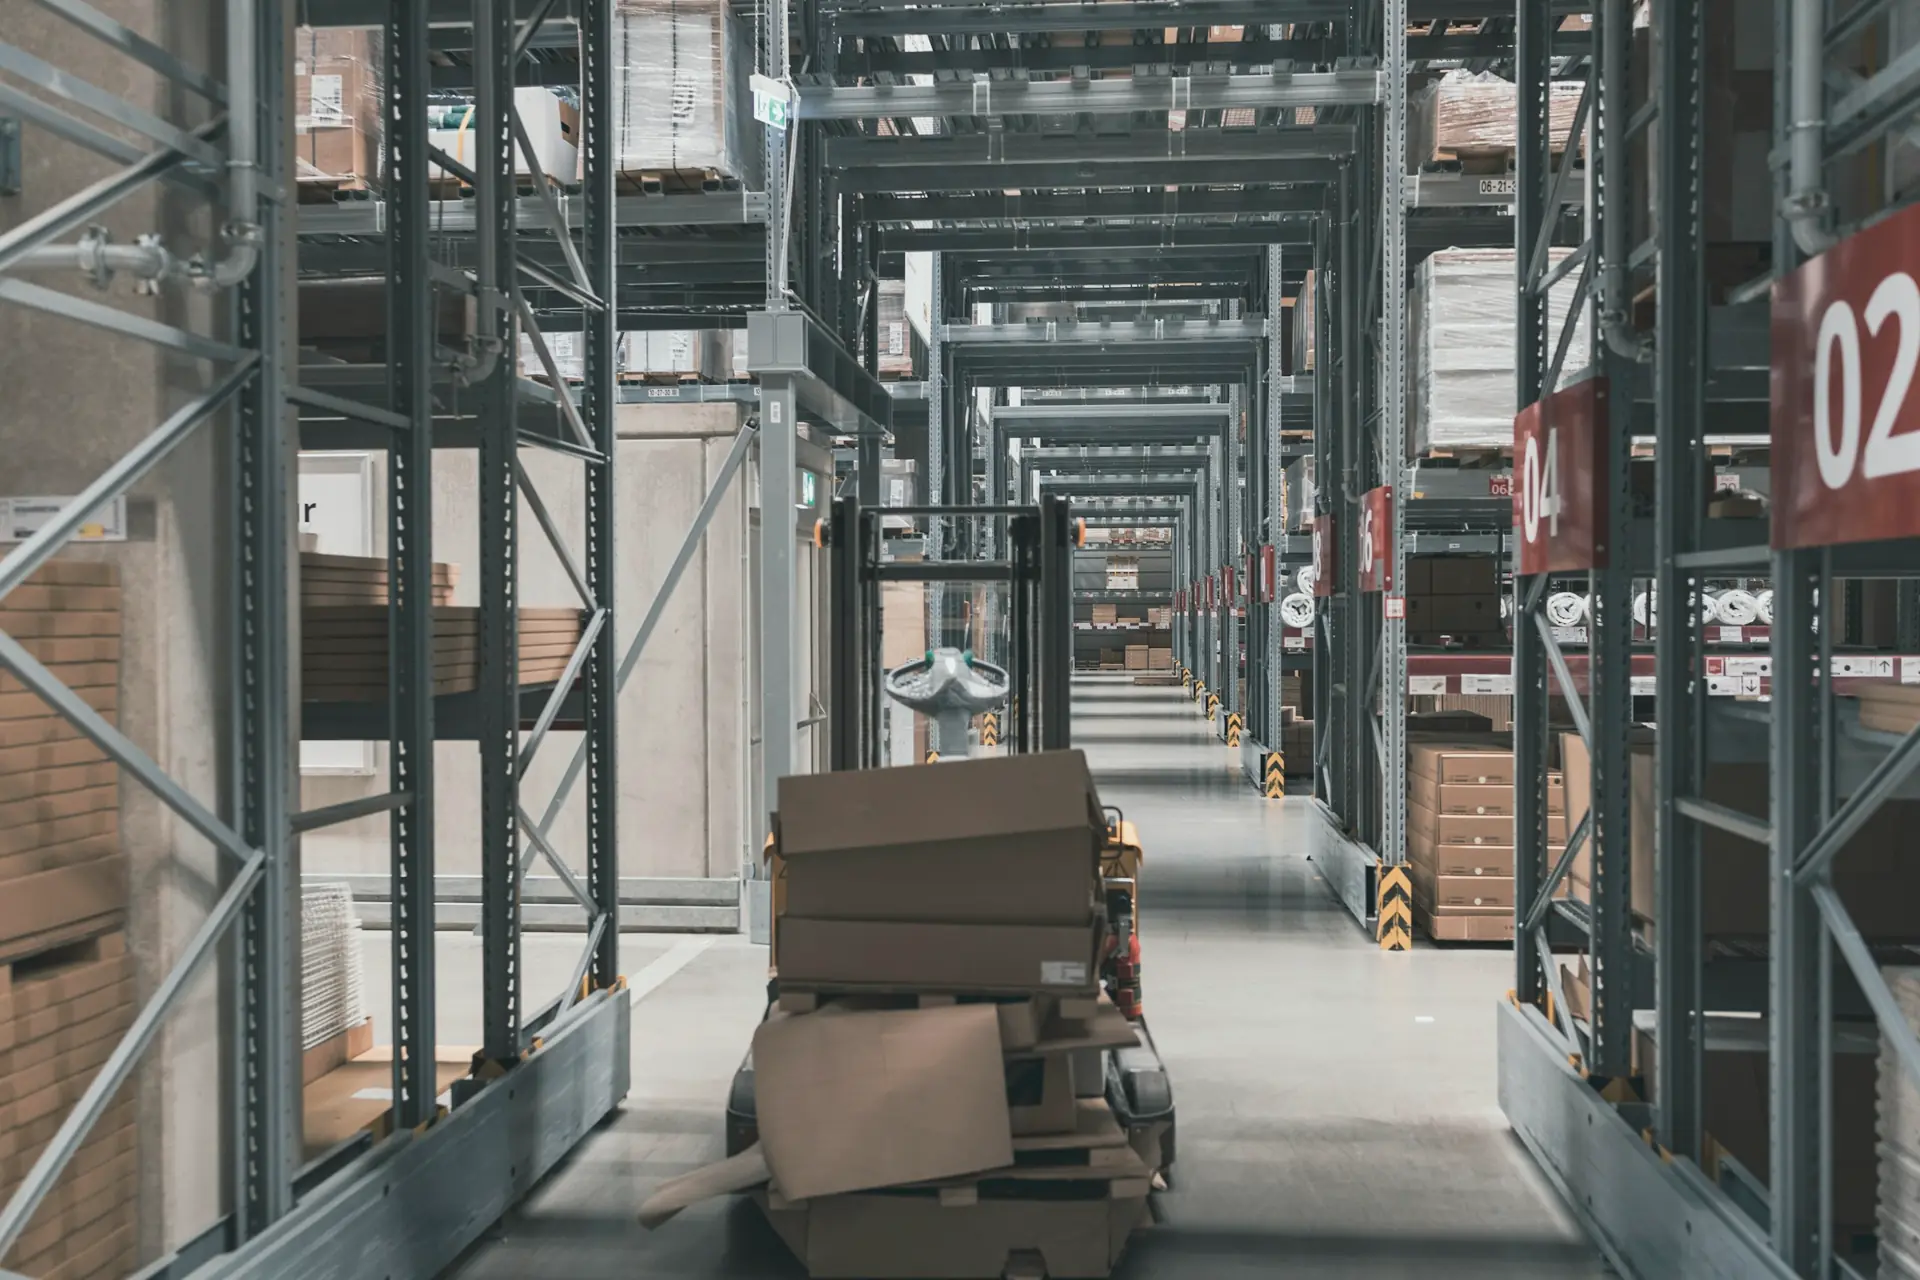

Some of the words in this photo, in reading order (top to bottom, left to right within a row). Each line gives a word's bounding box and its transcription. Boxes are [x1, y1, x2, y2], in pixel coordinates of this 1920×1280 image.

[1814, 272, 1920, 490] 02
[1491, 484, 1508, 495] 06
[1523, 427, 1561, 544] 04
